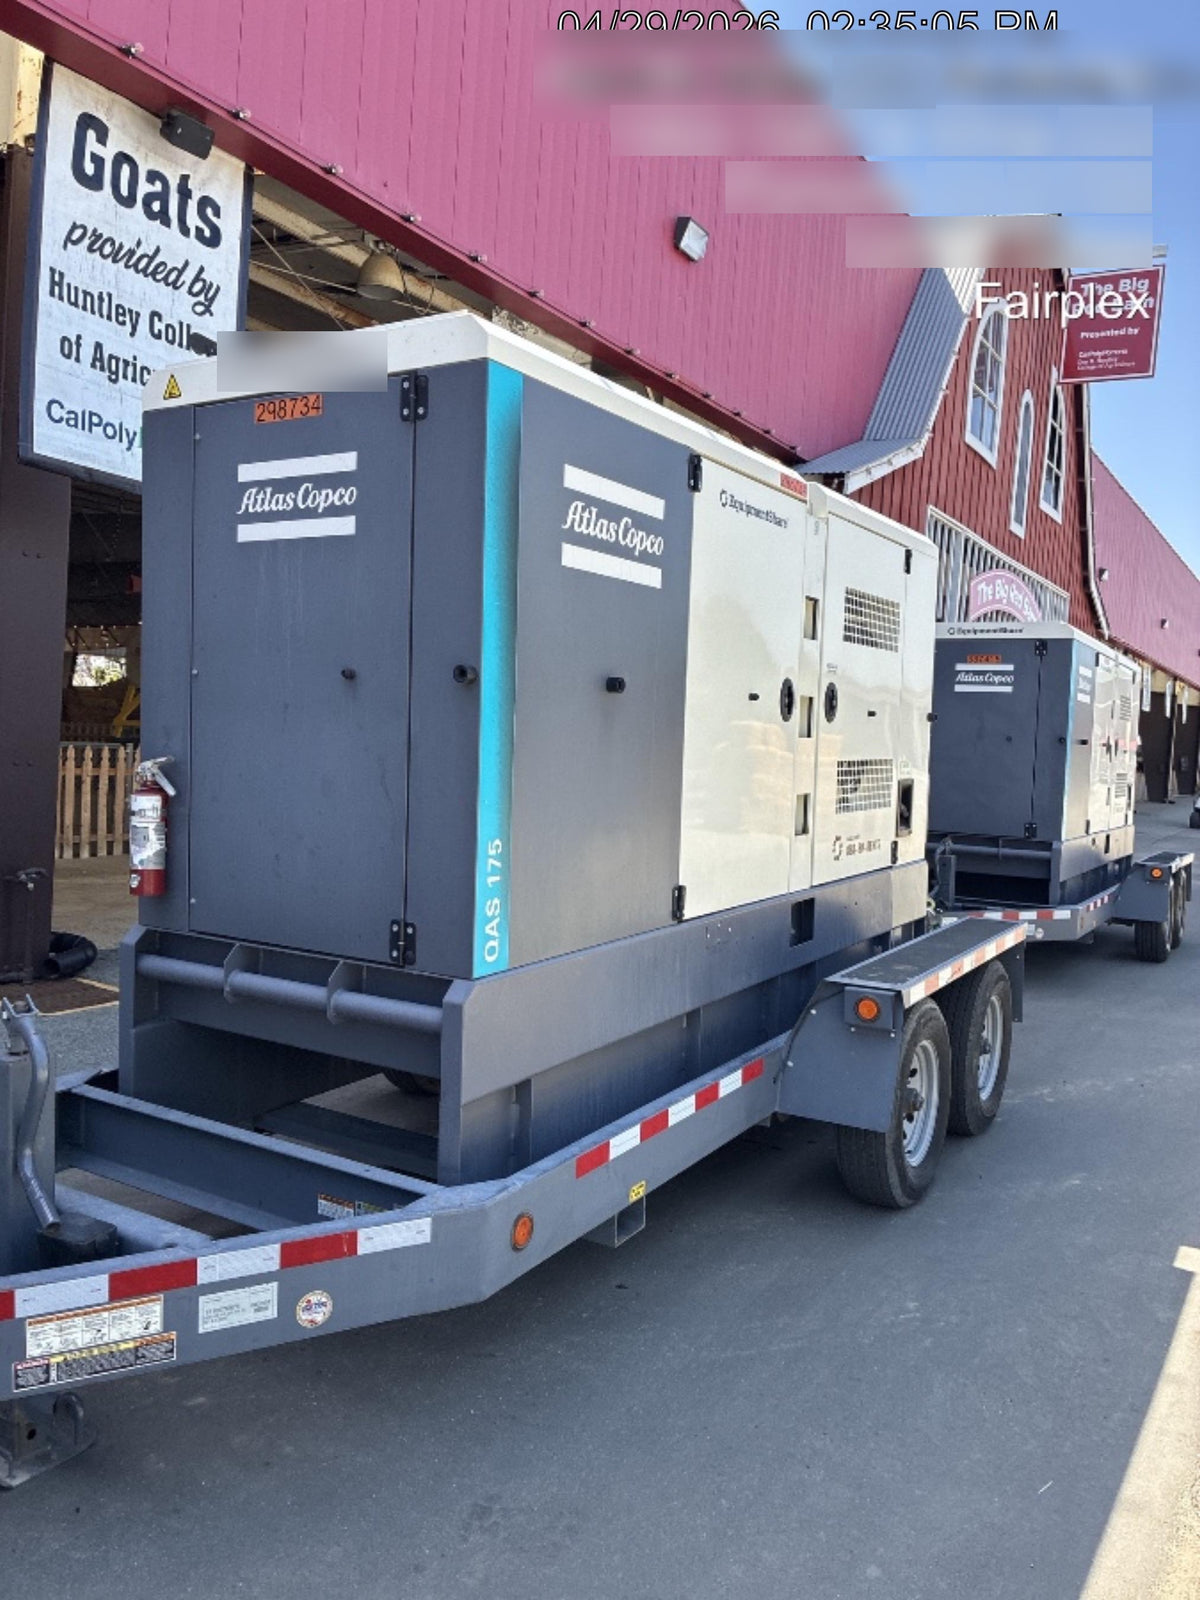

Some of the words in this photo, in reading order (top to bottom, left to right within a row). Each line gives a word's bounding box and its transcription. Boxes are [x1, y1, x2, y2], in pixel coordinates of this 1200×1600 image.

[72, 112, 222, 249] Goats
[63, 222, 190, 290] provided
[187, 264, 221, 317] by
[1119, 276, 1149, 294] Big
[49, 266, 141, 338] Huntley
[149, 310, 193, 352] Coll
[59, 334, 82, 364] of
[90, 341, 154, 386] Agric
[46, 398, 137, 451] CalPoly
[256, 394, 321, 422] 298734
[486, 838, 503, 888] 175
[484, 897, 501, 963] QAS
